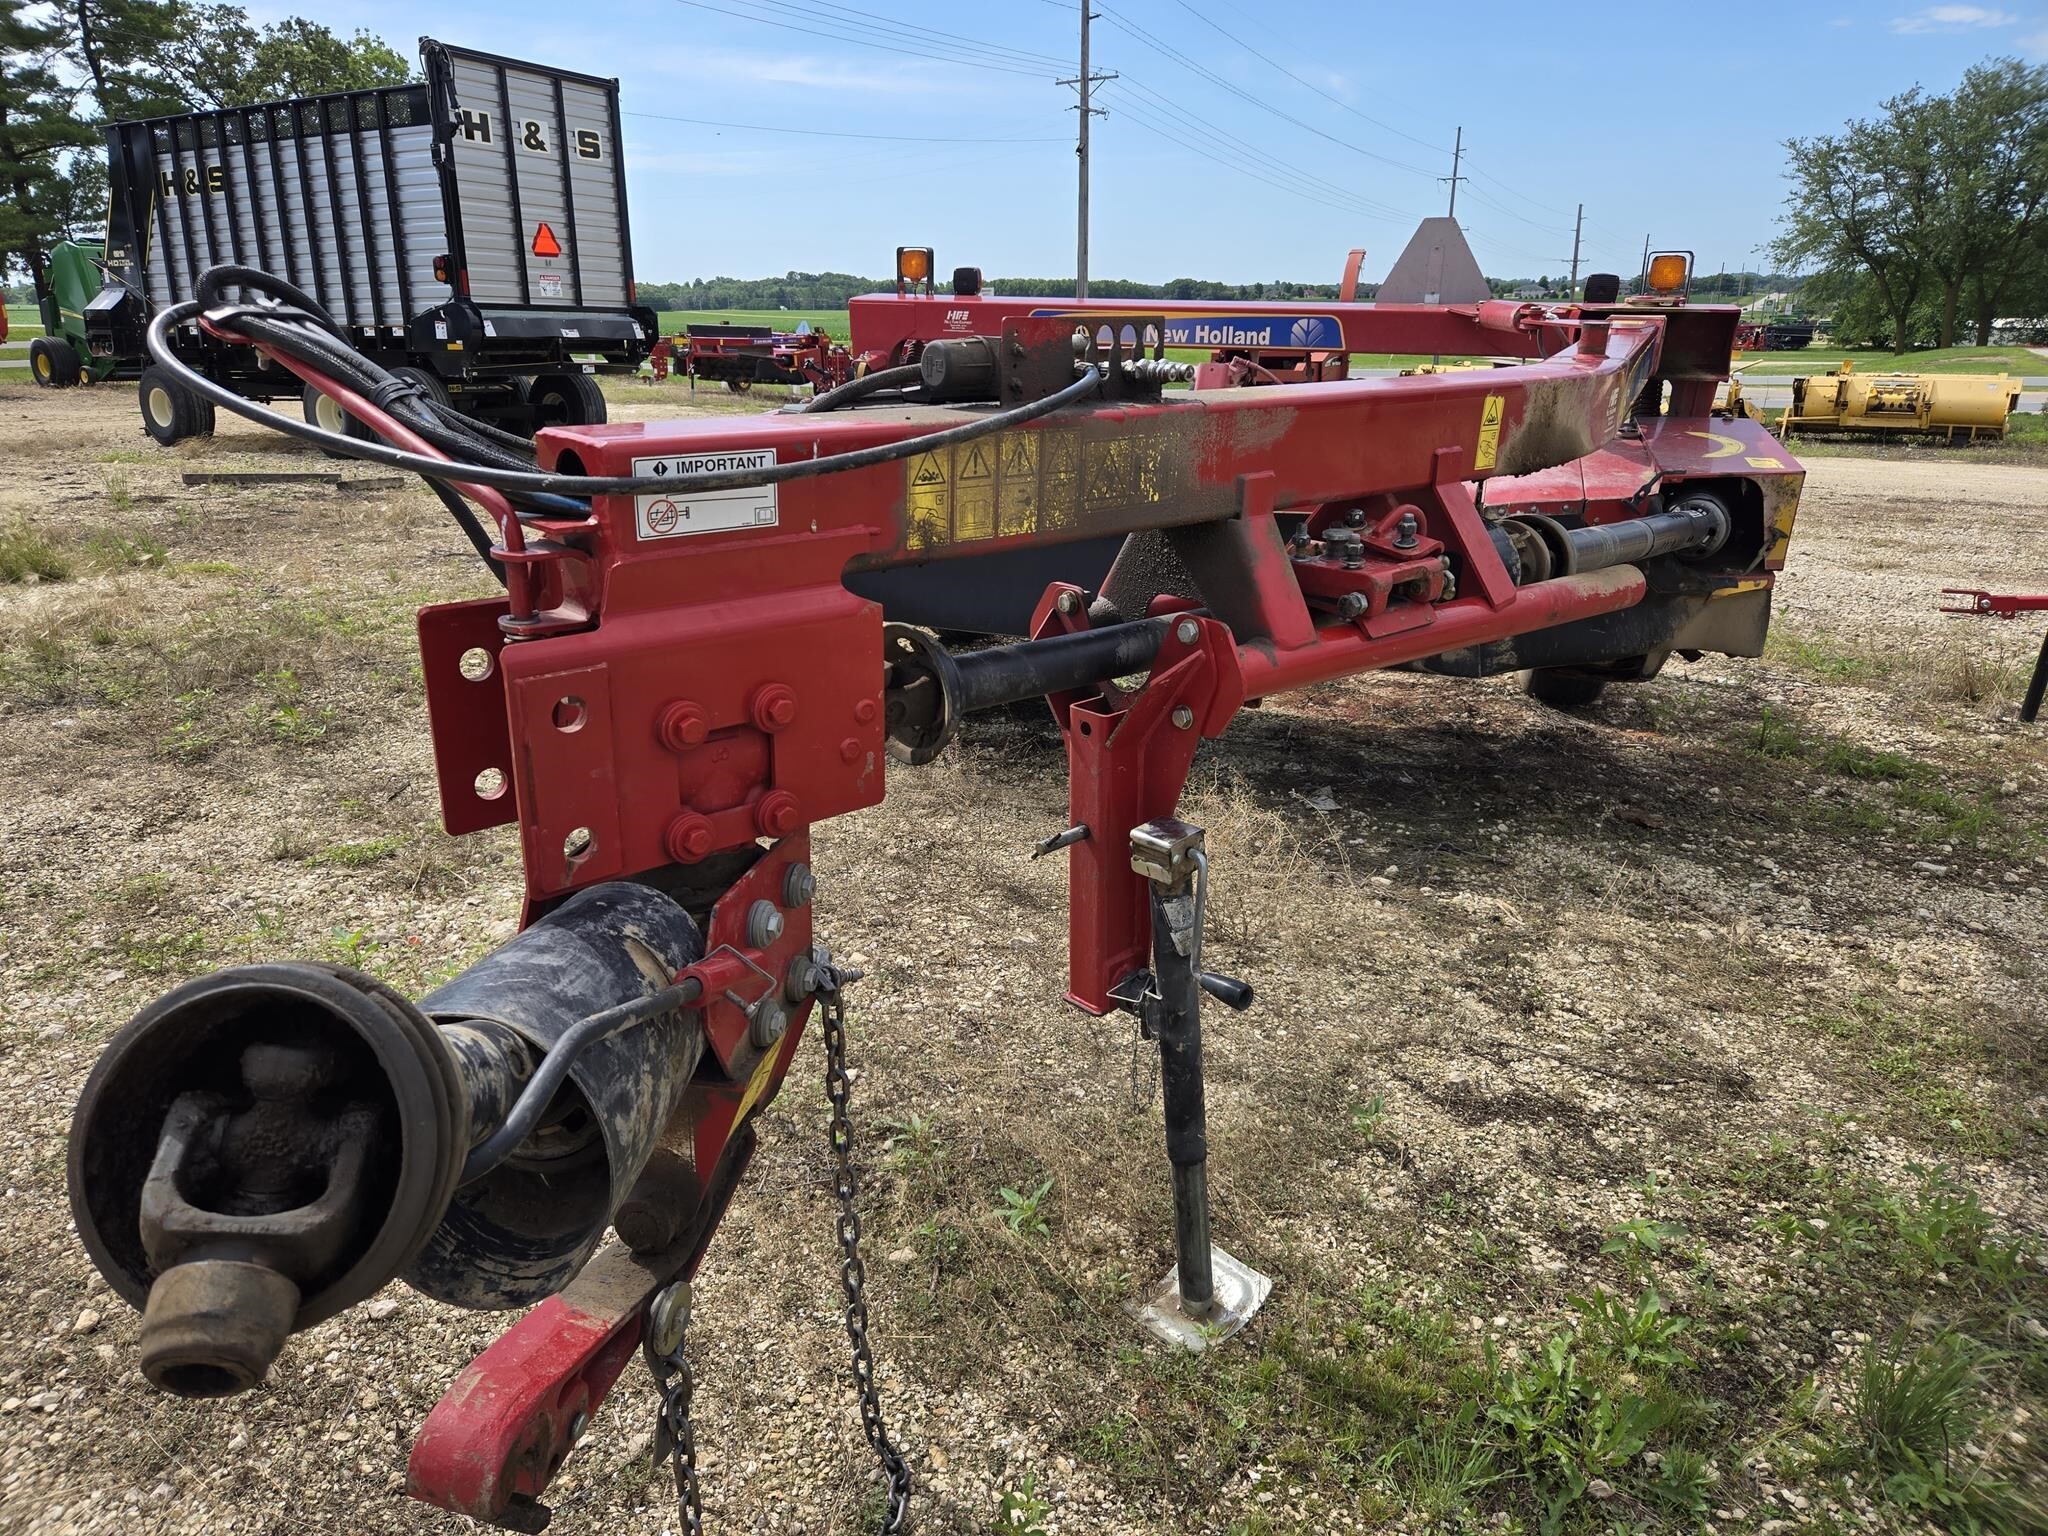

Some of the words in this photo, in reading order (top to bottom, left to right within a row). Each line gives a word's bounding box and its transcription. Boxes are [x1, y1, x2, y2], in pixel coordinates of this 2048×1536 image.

[461, 109, 491, 143] H
[524, 121, 548, 152] &
[577, 130, 601, 159] S
[161, 170, 178, 197] H
[185, 168, 201, 196] &
[1145, 326, 1190, 343] New
[1195, 325, 1271, 345] Holland
[676, 455, 767, 474] IMPORTANT
